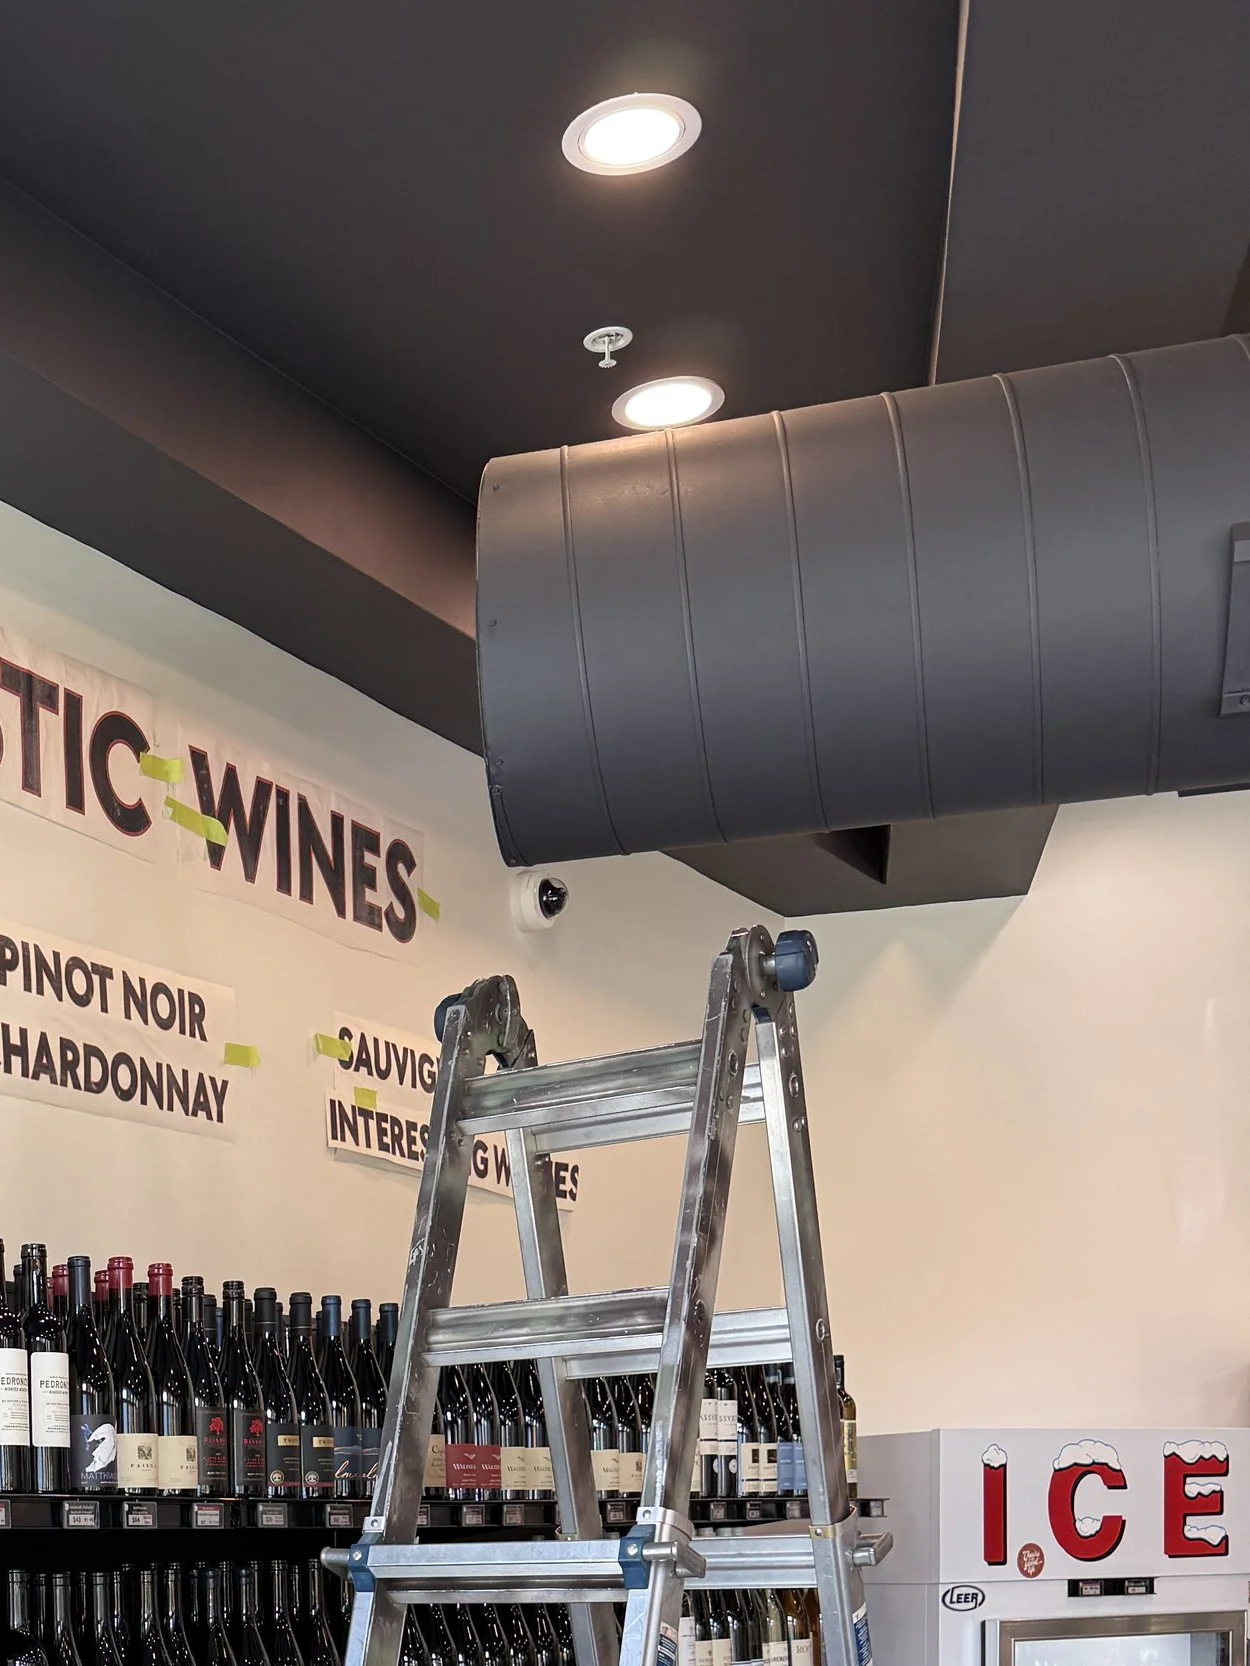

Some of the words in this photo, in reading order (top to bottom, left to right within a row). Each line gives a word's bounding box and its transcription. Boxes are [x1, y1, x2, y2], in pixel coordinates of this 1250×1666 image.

[188, 745, 417, 943] WINES
[123, 976, 207, 1042] NOIR
[338, 1027, 440, 1094] SAUVIG
[494, 1144, 579, 1202] WES
[982, 1439, 1230, 1566] ICE
[949, 1588, 979, 1607] LEER
